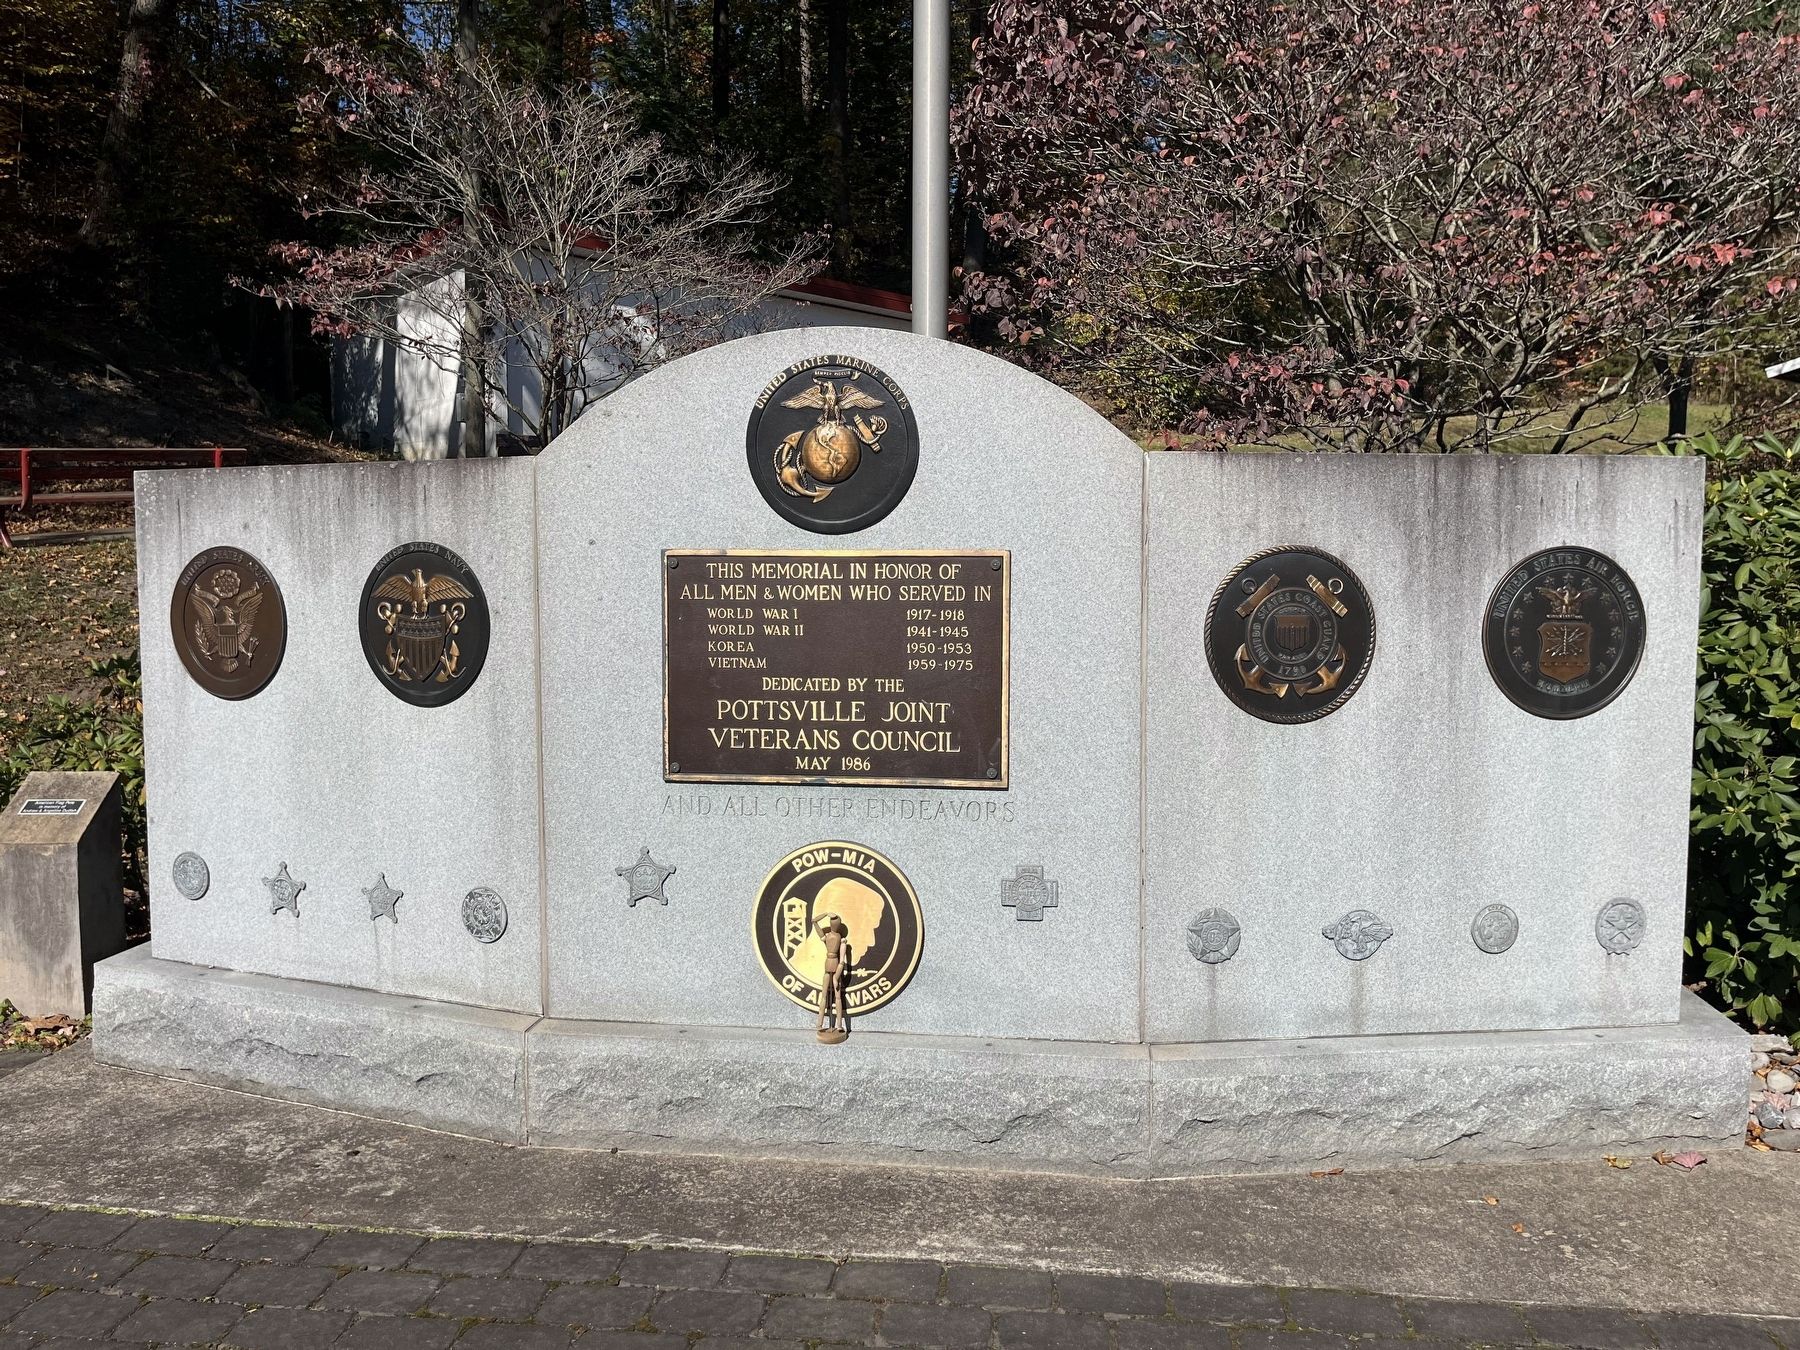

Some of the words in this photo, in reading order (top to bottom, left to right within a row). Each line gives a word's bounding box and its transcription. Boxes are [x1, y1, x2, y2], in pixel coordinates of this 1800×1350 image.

[756, 372, 787, 408] UNITED
[791, 356, 829, 373] STATES
[836, 355, 880, 377] MARINE
[882, 377, 909, 410] CORPS
[213, 550, 243, 562] STATES
[375, 546, 404, 571] UNITED
[410, 543, 439, 553] STATES
[445, 551, 469, 574] NAVY
[706, 563, 744, 579] THIS
[751, 563, 844, 579] MEMORIAL
[850, 563, 867, 579] IN
[874, 563, 932, 580] HONOR
[939, 564, 962, 580] OF
[680, 584, 714, 600] ALL
[720, 584, 757, 600] MEN
[763, 586, 775, 600] &
[776, 584, 842, 601] WOMEN
[849, 585, 891, 601] WHO
[899, 585, 966, 601] SERVED
[974, 585, 992, 601] IN
[1493, 570, 1528, 618] UNITED
[1534, 553, 1581, 571] STATES
[1586, 556, 1608, 577] AIR
[1609, 573, 1640, 621] FORCE
[707, 607, 753, 619] WORLD
[762, 608, 790, 619] WAR
[793, 608, 798, 620] I
[708, 624, 755, 636] WORLD
[763, 624, 791, 636] WAR
[794, 624, 804, 636] II
[1257, 592, 1290, 620] STATES
[1295, 592, 1328, 617] COAST
[1317, 620, 1332, 660] GUARD
[708, 641, 755, 652] KOREA
[708, 657, 768, 669] VIETNAM
[762, 677, 840, 692] DEDICATED
[847, 678, 868, 692] BY
[875, 679, 905, 693] THE
[717, 699, 866, 722] POTTSVILLE
[881, 701, 951, 724] JOINT
[707, 727, 840, 750] VETERANS
[852, 730, 961, 753] COUNCIL
[795, 756, 831, 770] MAY
[841, 756, 871, 771] 1986
[662, 794, 712, 815] AND
[722, 795, 767, 817] ALL
[775, 797, 853, 818] OTHER
[867, 798, 1015, 823] ENDEAVORS
[792, 849, 876, 873] POW-MIA
[782, 974, 805, 993] OF
[845, 977, 892, 1006] WARS
